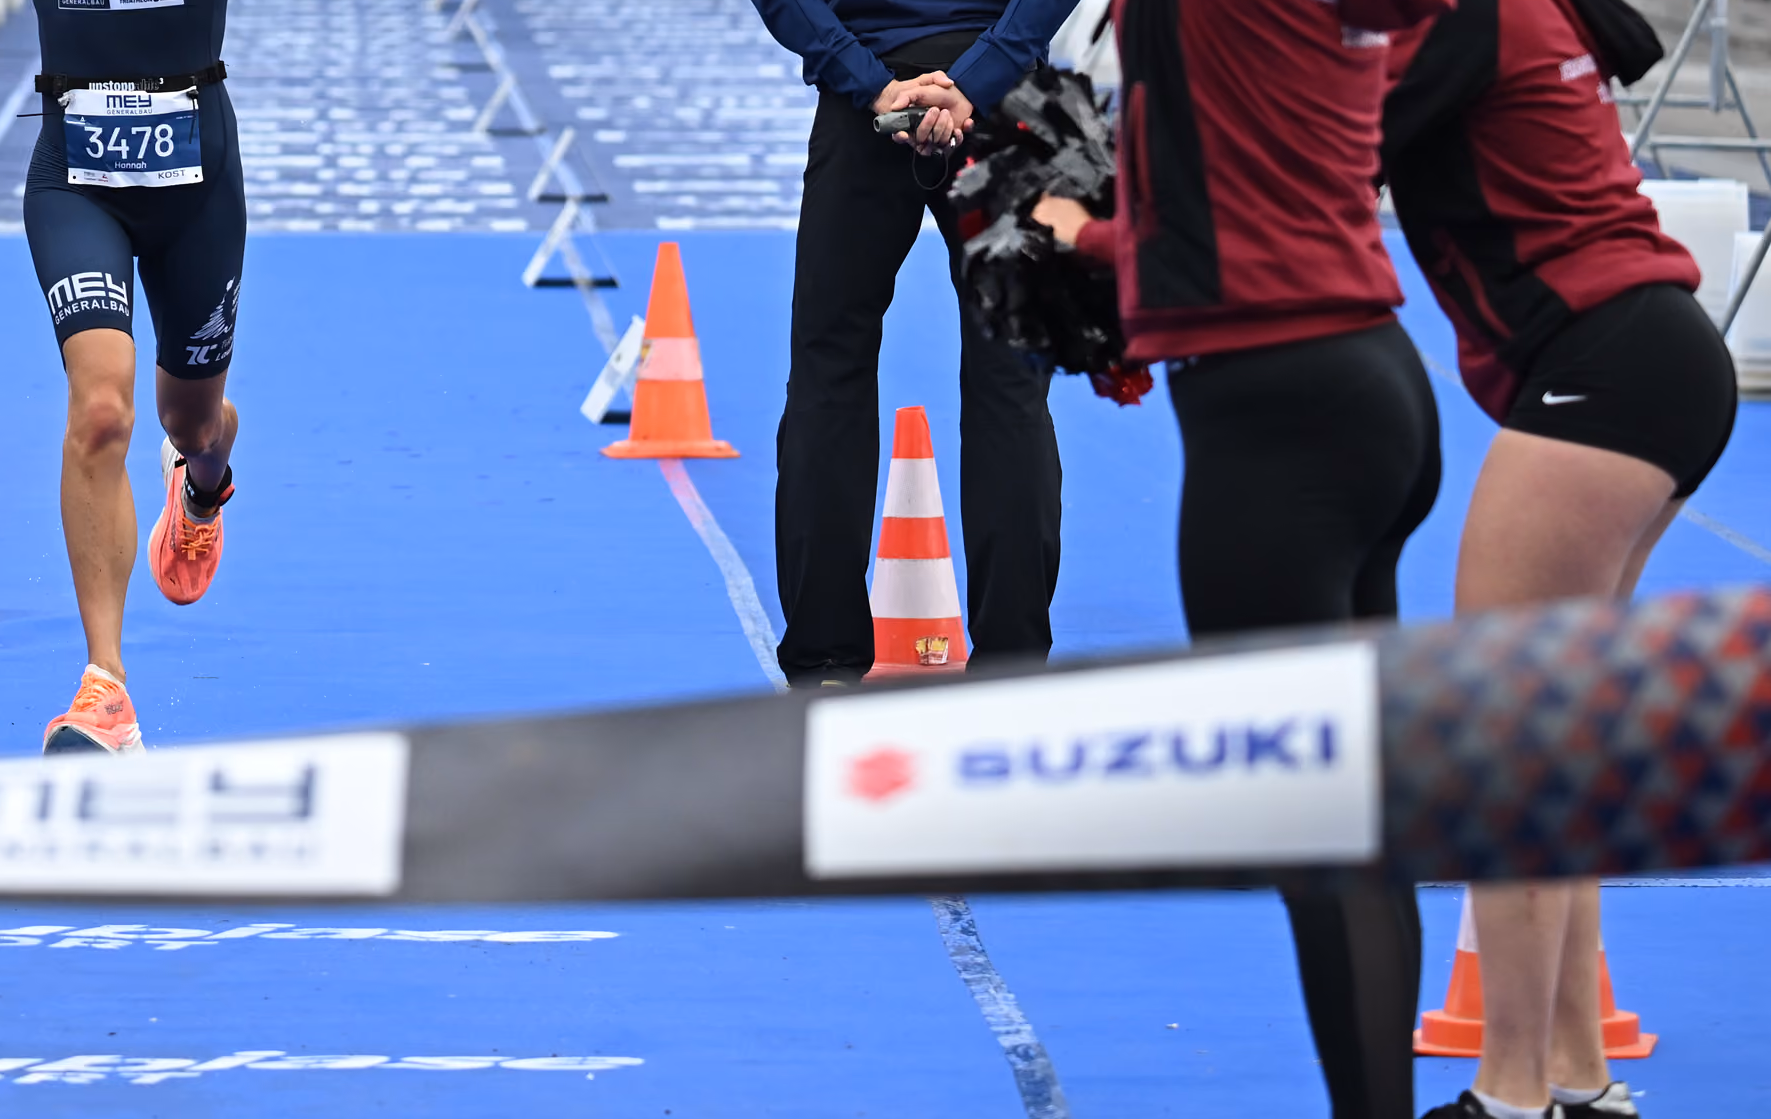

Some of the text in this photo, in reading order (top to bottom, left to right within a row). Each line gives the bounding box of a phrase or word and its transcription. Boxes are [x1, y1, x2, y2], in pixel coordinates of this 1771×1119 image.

[106, 95, 152, 108] MEY
[84, 124, 174, 160] 3478
[115, 161, 147, 169] Hannah
[158, 169, 186, 179] KOST
[47, 272, 128, 315] MEY
[55, 299, 130, 325] GENERALBAU
[954, 714, 1340, 789] SUZUKI
